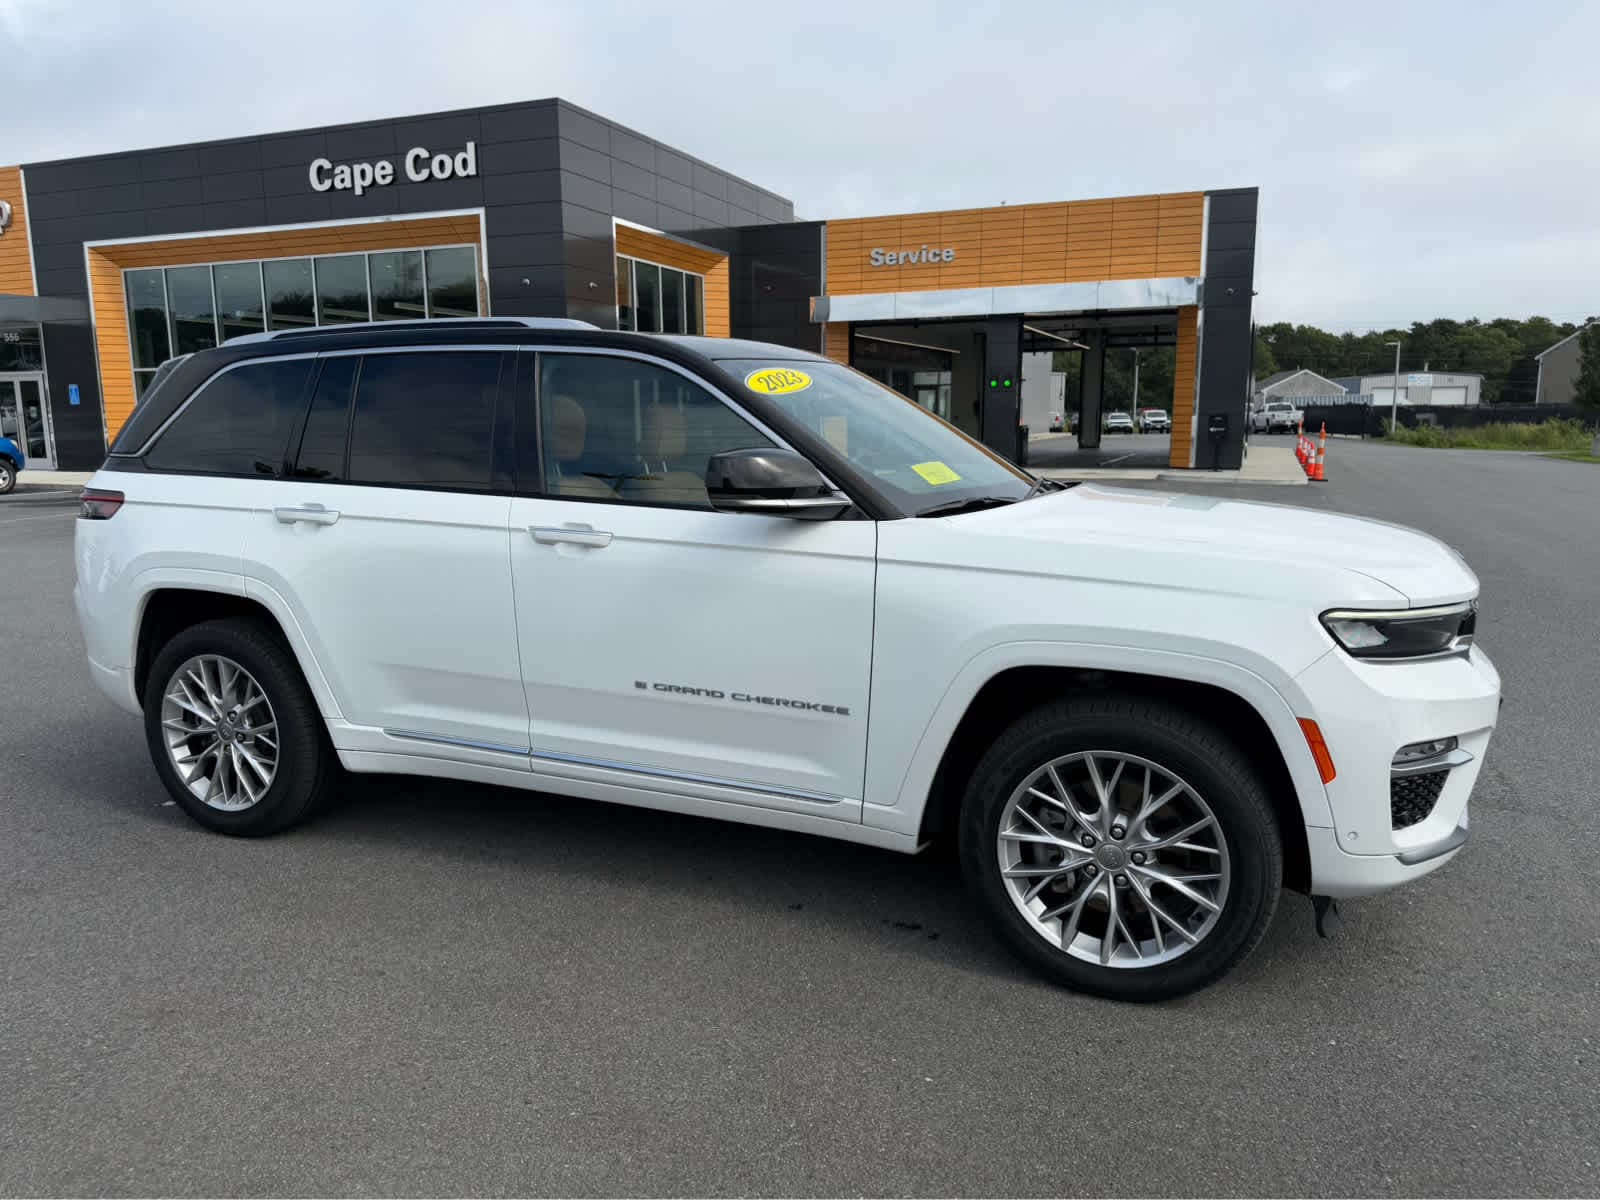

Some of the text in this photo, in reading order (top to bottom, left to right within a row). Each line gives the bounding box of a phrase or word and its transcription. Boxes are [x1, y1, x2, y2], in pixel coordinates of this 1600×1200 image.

[309, 141, 477, 195] Cape Cod
[870, 244, 955, 266] Service
[757, 370, 803, 391] 2023
[653, 682, 850, 716] GRAND CHEROKEE
